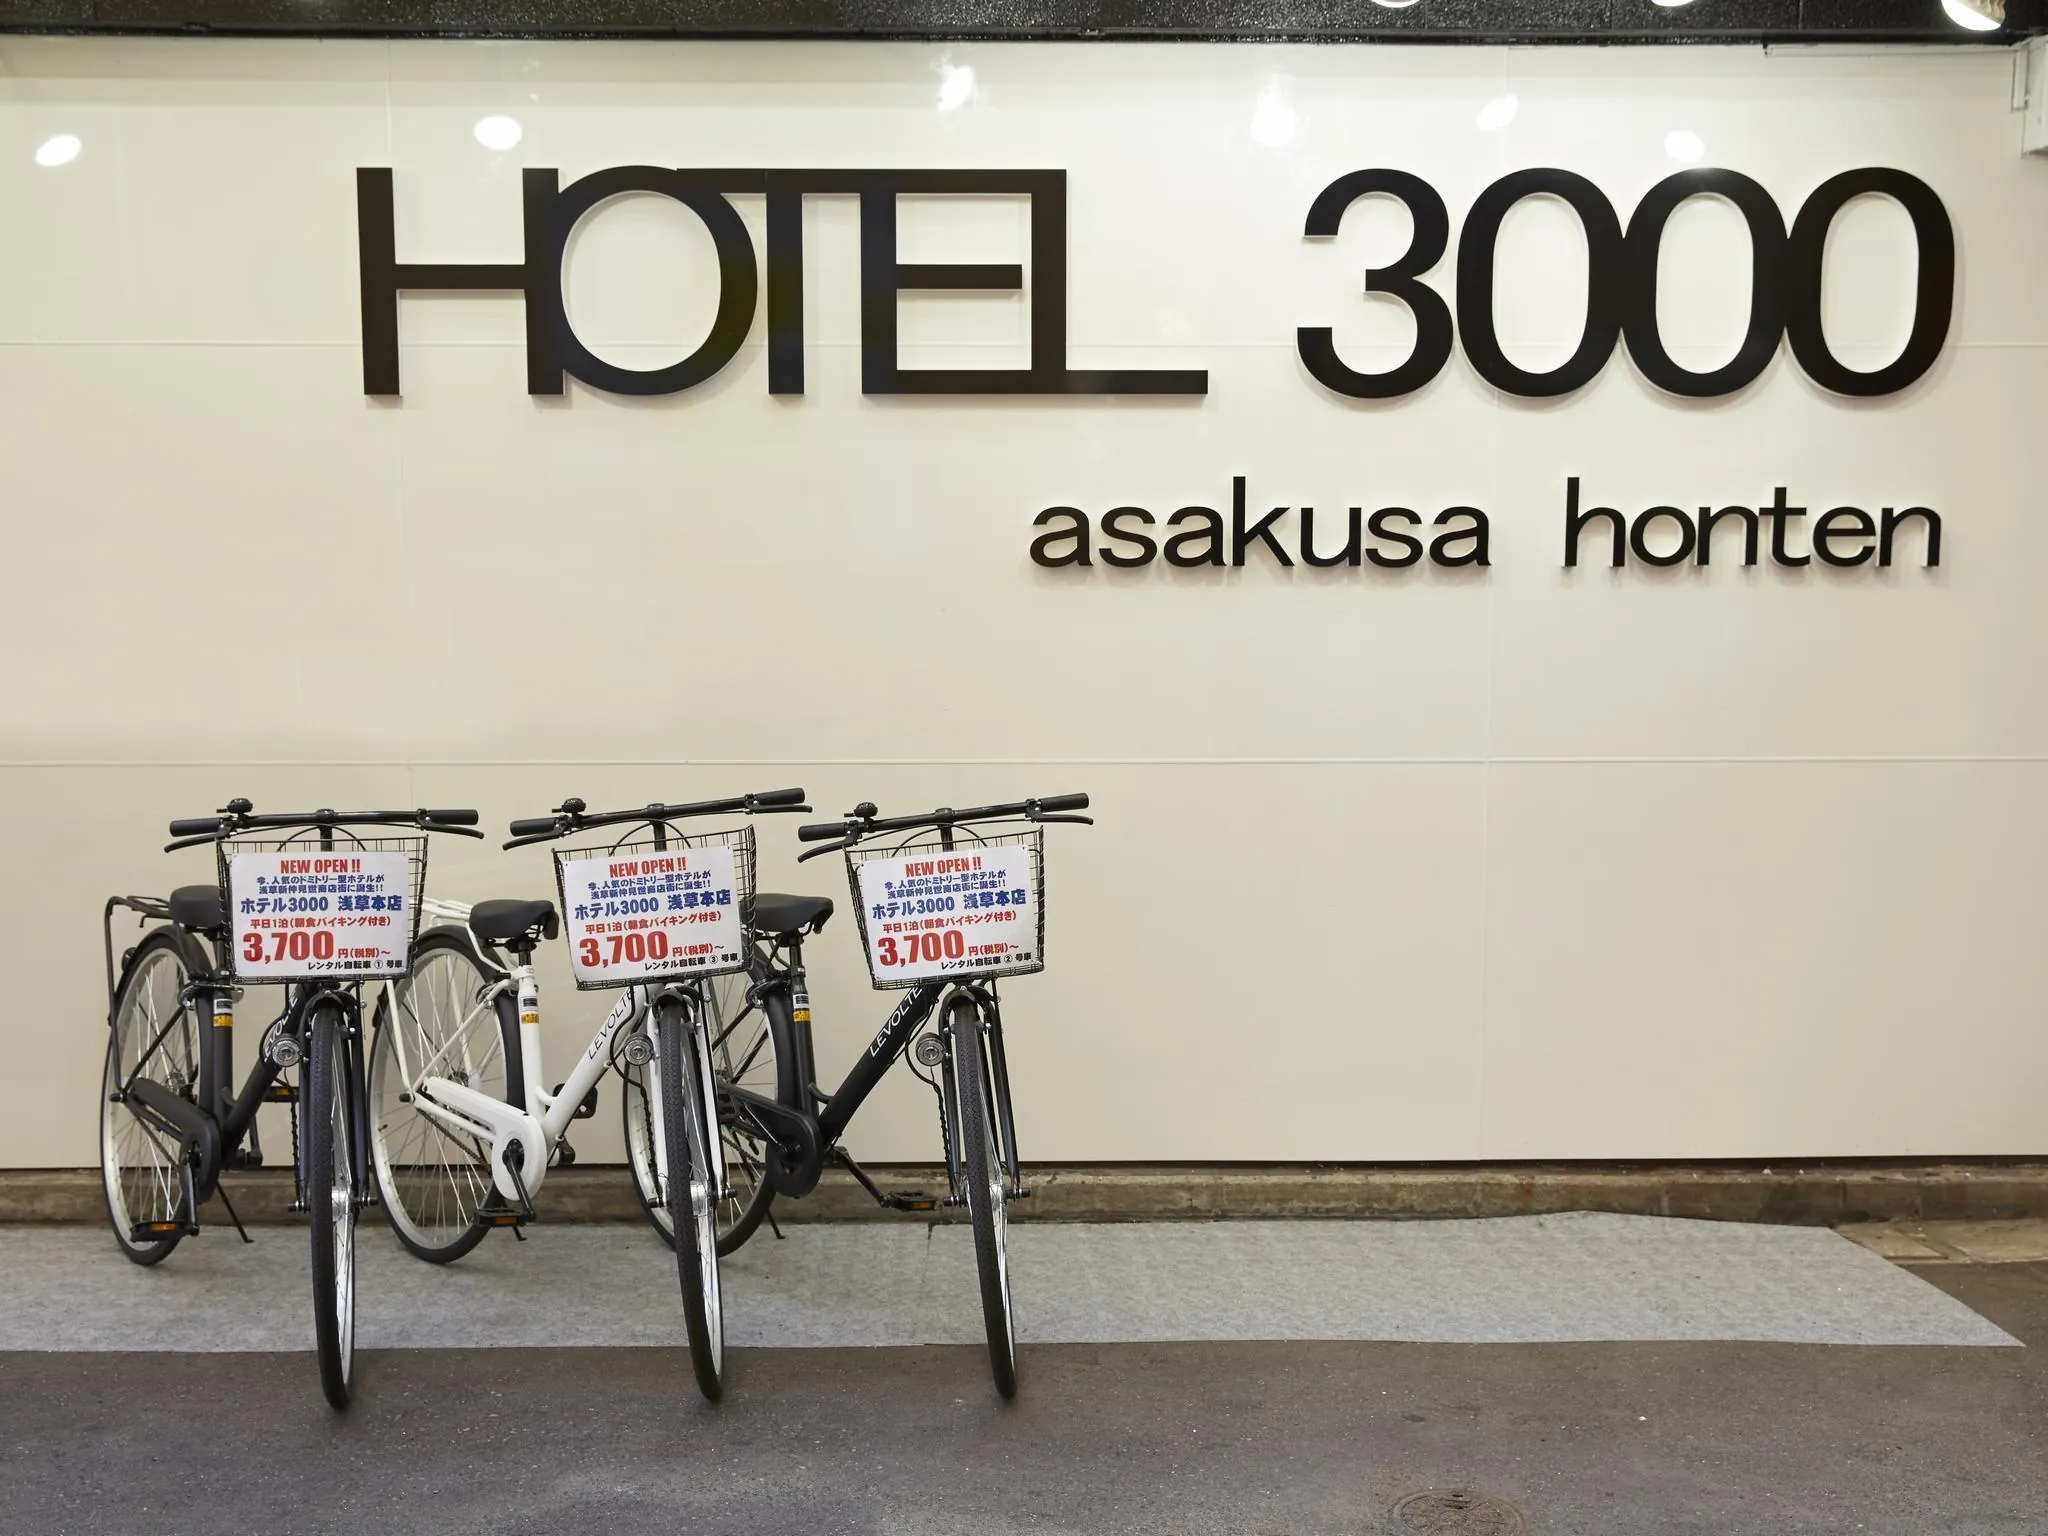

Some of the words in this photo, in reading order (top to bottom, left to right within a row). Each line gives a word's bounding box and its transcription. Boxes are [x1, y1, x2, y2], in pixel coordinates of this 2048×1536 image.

[357, 165, 1208, 396] HOTEL
[1297, 167, 1955, 398] 3000
[1030, 476, 1491, 568] asakusa
[1565, 477, 1941, 568] honten
[280, 860, 310, 874] NEW
[315, 860, 348, 873] OPEN
[609, 863, 638, 878] NEW
[642, 858, 674, 874] OPEN
[905, 862, 934, 877] NEW
[937, 858, 969, 874] OPEN
[241, 897, 329, 914] ホテル3000
[338, 896, 402, 912] 浅草本店
[575, 897, 659, 920] ホテル3000
[668, 889, 731, 910] 浅草本店
[872, 897, 954, 919] ホテル3000
[964, 889, 1026, 910] 浅草本店
[243, 931, 334, 964] 3,700
[580, 931, 668, 969] 3,700
[877, 930, 964, 967] 3,700
[308, 962, 371, 970] レンタル自転車
[387, 960, 403, 969] 号車
[645, 957, 706, 971] レンタル自転車
[722, 953, 738, 962] 号車
[941, 957, 1001, 970] レンタル自転車
[1016, 952, 1031, 962] 号車
